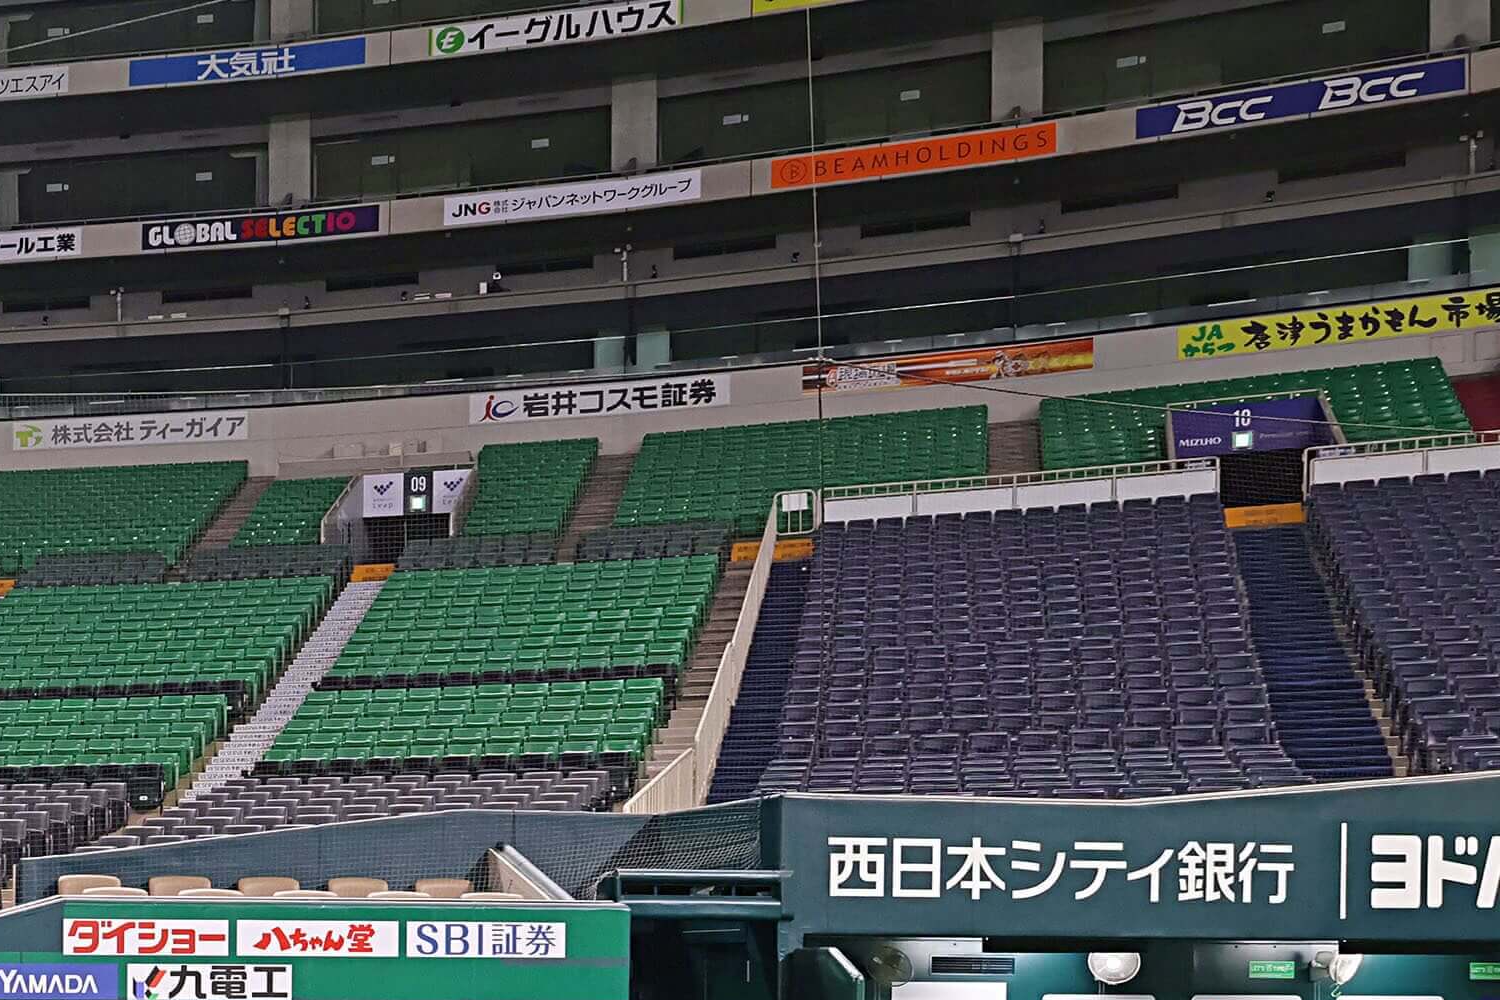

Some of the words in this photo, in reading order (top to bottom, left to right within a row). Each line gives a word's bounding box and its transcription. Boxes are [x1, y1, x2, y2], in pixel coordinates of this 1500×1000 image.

[467, 1, 676, 49] イーグルハウス
[196, 47, 296, 80] 大気社
[1318, 72, 1426, 110] BCC
[1172, 96, 1274, 133] BCC
[814, 130, 1048, 177] BEAMHOLDINGS
[452, 201, 491, 218] JNG
[511, 178, 692, 212] ジャパンネットワークグループ
[148, 220, 237, 247] GLOBAL
[240, 210, 358, 239] SELECTIO
[1182, 341, 1237, 358] からつ
[1191, 324, 1225, 341] JA
[522, 378, 717, 418] 岩井コスモ証券
[51, 422, 135, 445] 株式会社
[139, 416, 246, 441] ティーガイア
[410, 476, 427, 493] 09
[826, 834, 1296, 905] 西日本シティ銀行
[67, 919, 227, 955] ダイショー
[252, 923, 377, 954] 八ちゃん堂
[415, 922, 557, 956] SBI証券
[168, 964, 289, 1000] 九電工
